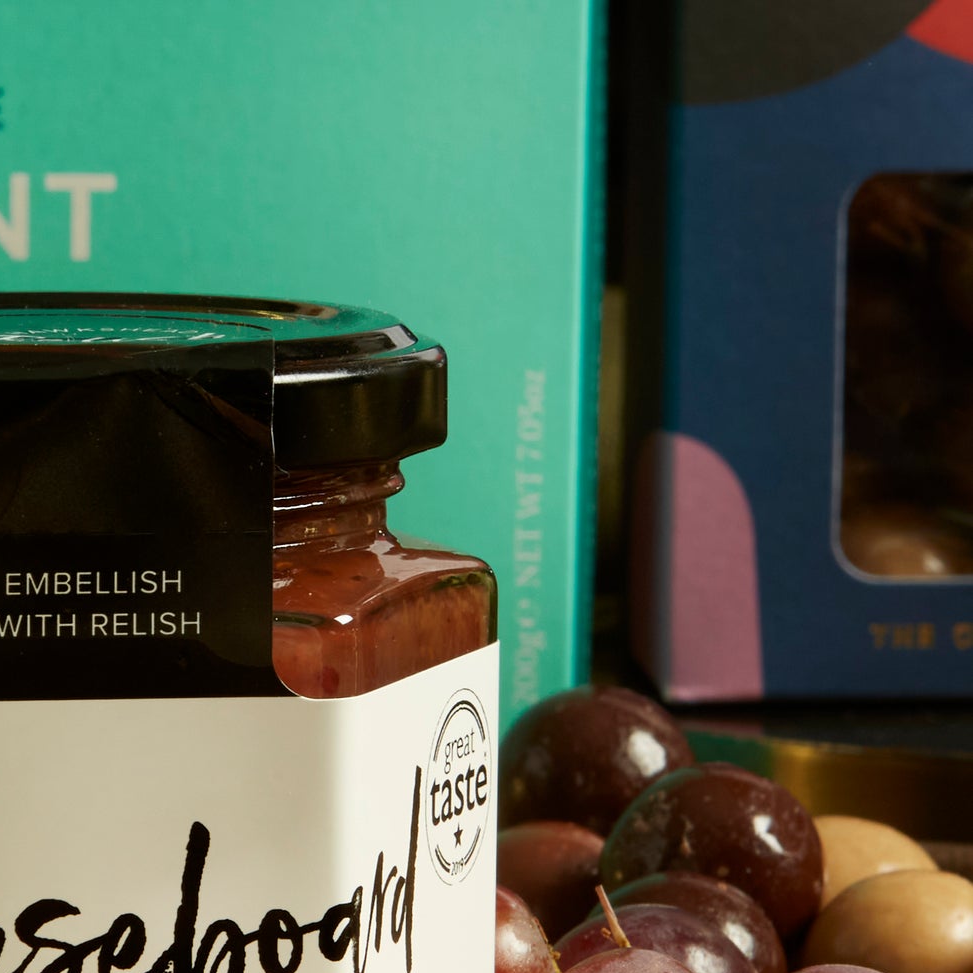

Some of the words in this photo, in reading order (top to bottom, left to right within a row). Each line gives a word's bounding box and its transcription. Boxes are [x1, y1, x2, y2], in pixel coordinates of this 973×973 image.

[5, 570, 182, 596] EMBELLISH
[91, 611, 201, 636] RELISH
[444, 727, 475, 774] great
[429, 763, 488, 827] taste
